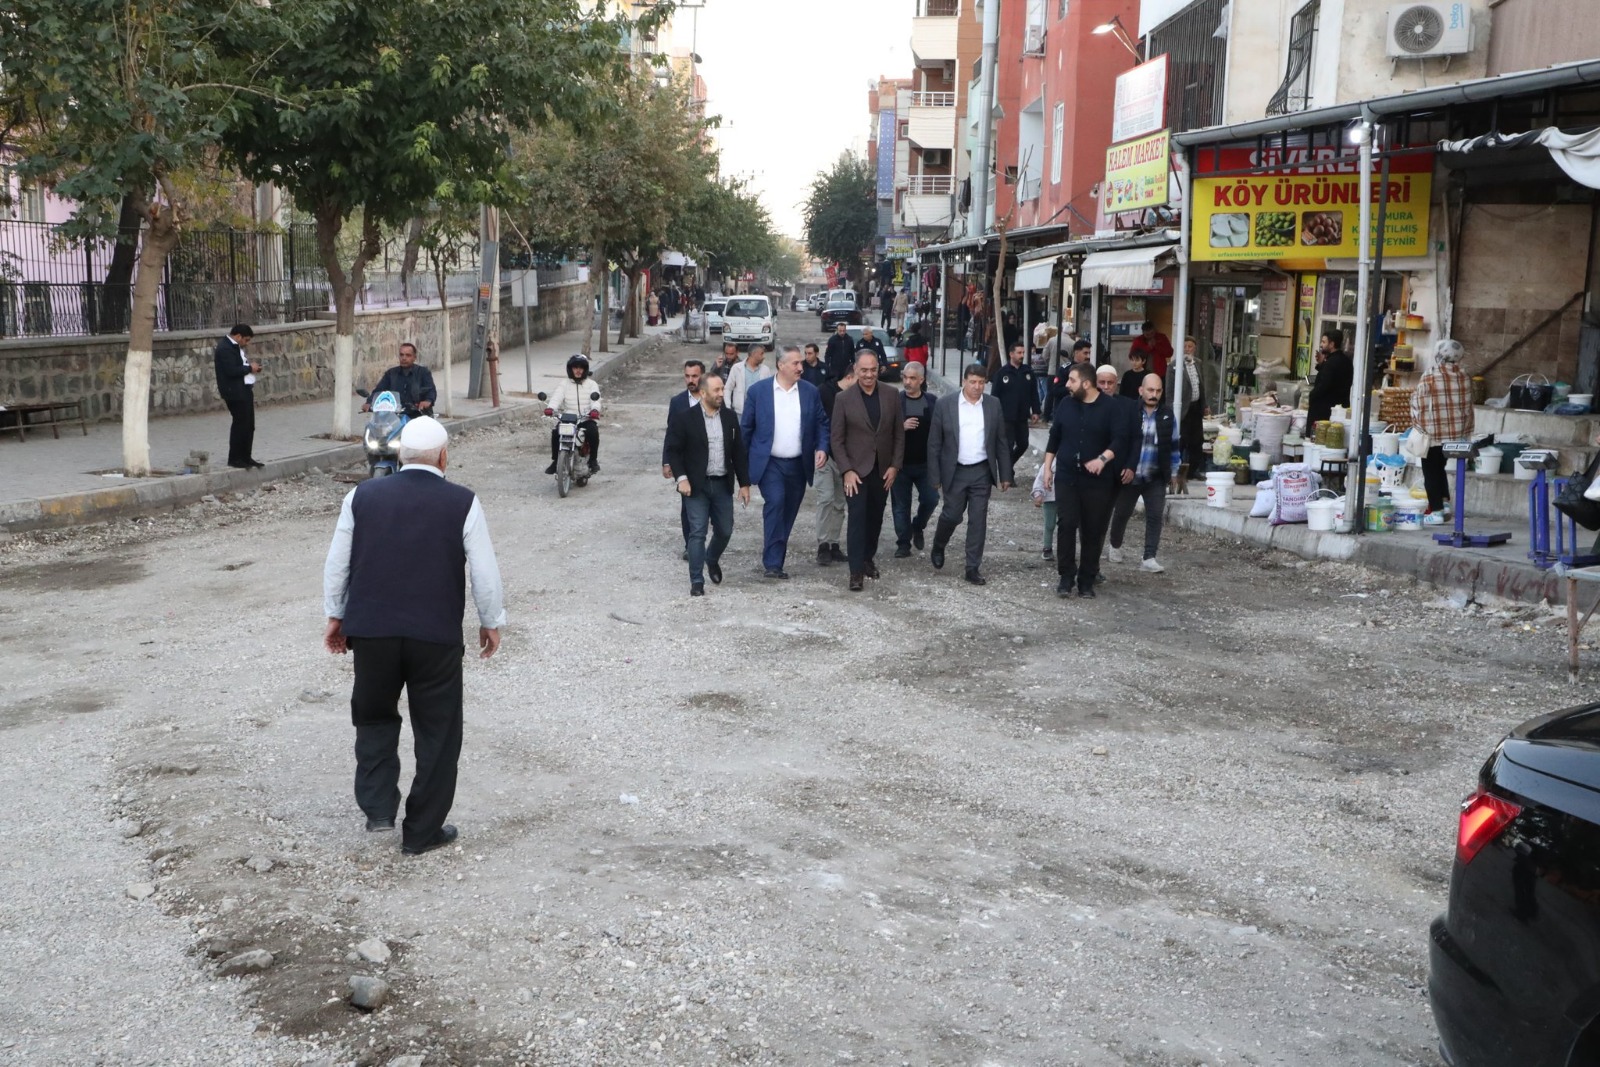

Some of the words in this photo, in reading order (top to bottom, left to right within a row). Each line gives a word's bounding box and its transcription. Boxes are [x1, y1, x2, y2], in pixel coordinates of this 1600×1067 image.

[1449, 3, 1459, 29] beko
[1108, 146, 1134, 172] KALEM
[1134, 136, 1166, 165] MARKET
[1214, 179, 1269, 207] KÖY
[1274, 175, 1411, 206] ÜRÜNLERİ
